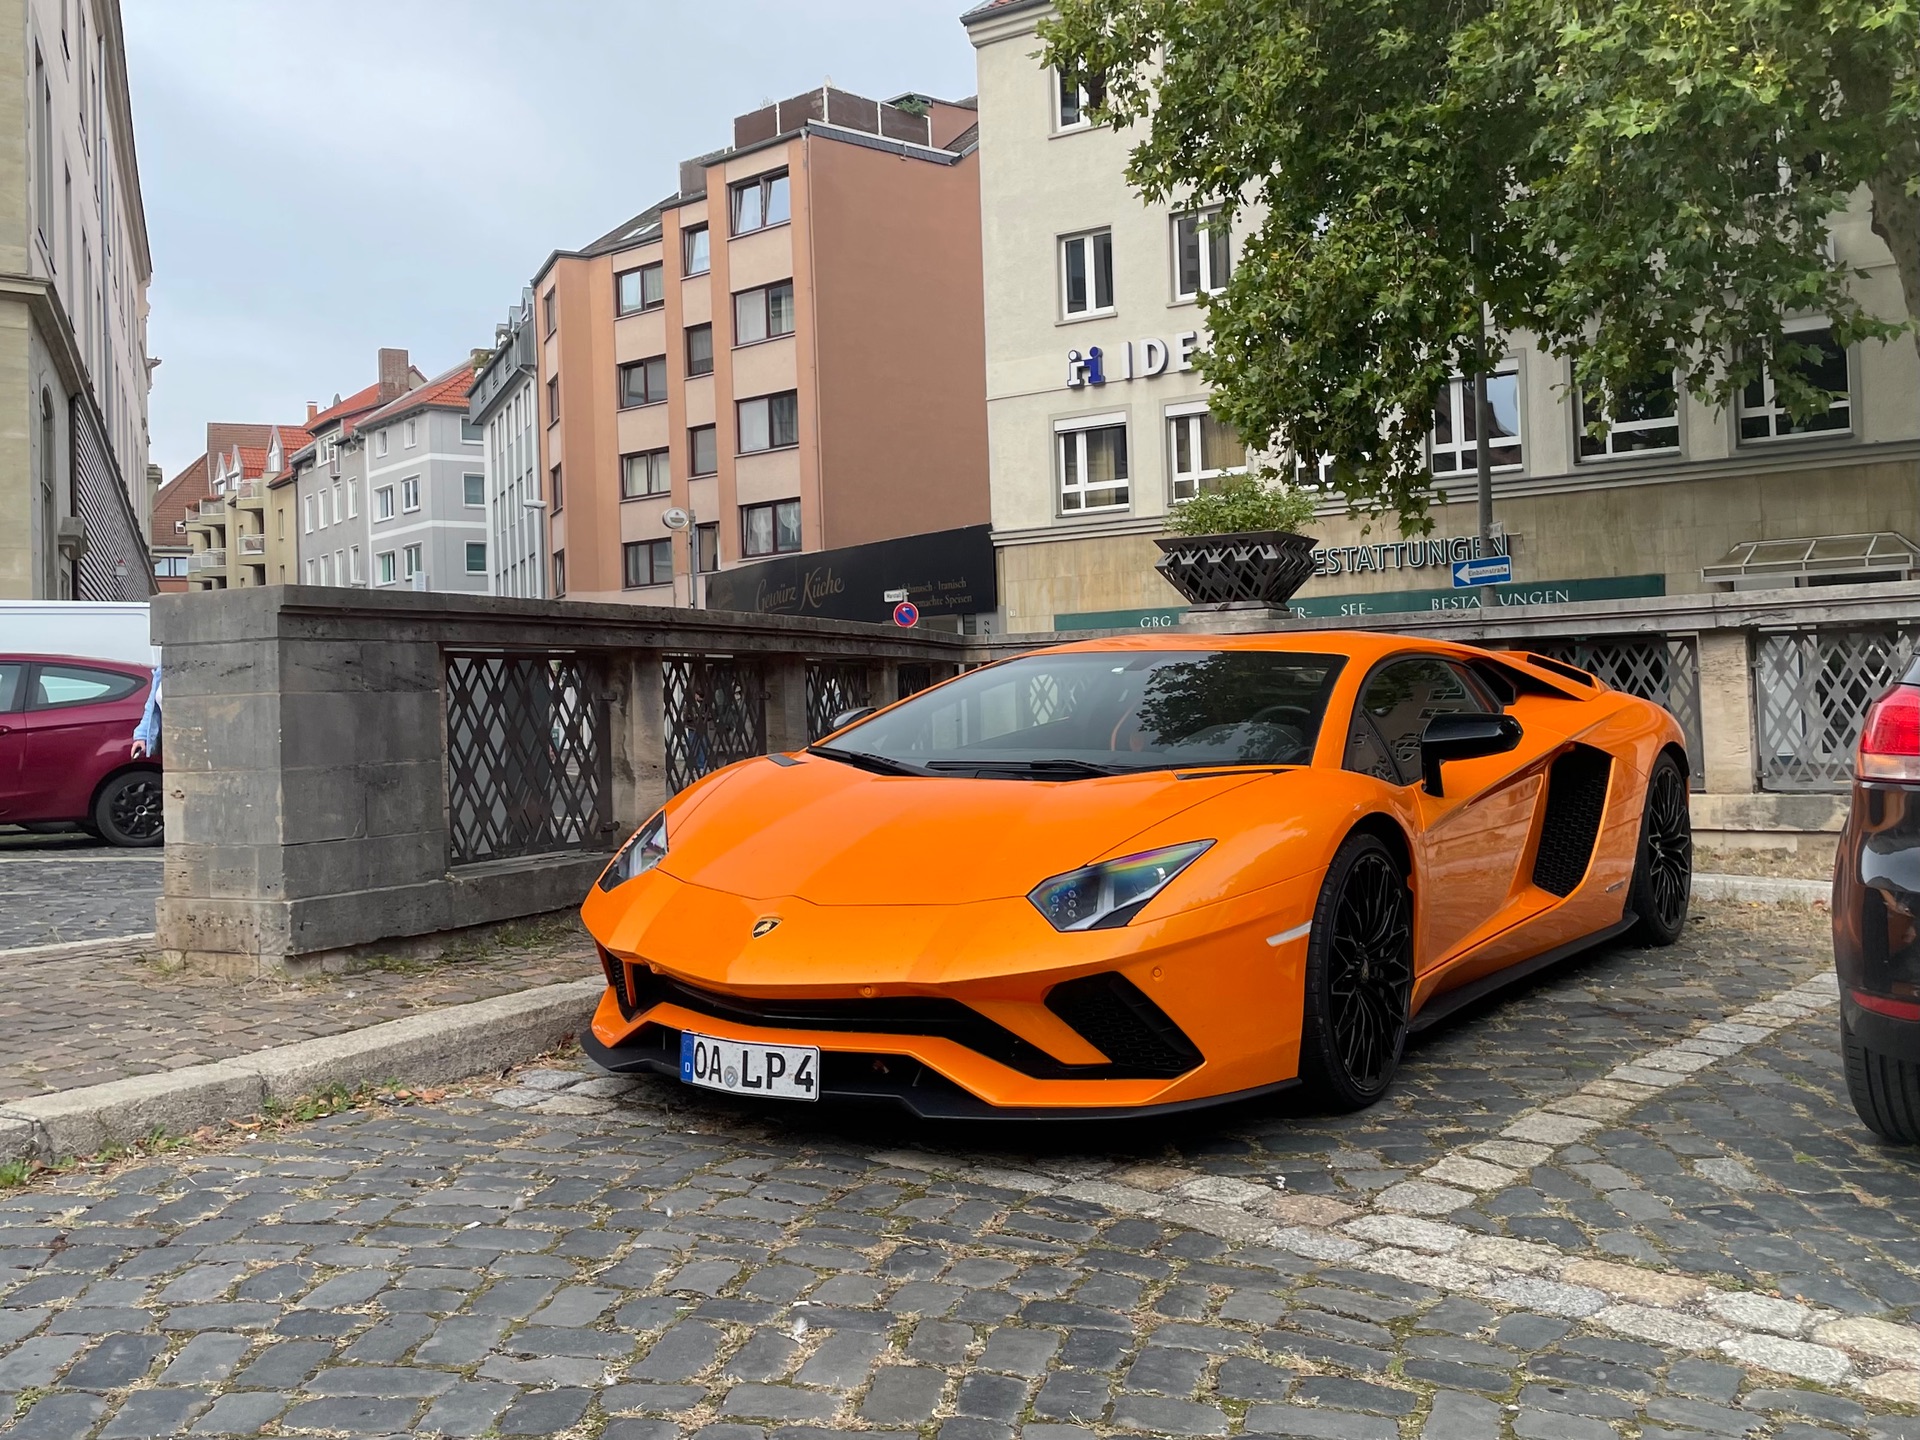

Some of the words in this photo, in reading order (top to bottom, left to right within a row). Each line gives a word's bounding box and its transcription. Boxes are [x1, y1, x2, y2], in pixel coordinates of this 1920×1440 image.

[1309, 533, 1509, 575] ESTATTUNGEN
[1468, 565, 1508, 577] Einbahnstraße
[756, 578, 797, 613] Gewürz
[799, 566, 845, 611] Küche
[938, 576, 967, 590] Iranisch
[944, 593, 972, 608] Speisen
[1431, 589, 1569, 611] BESTAUNGEN
[684, 1061, 691, 1073] D
[694, 1041, 722, 1083] OA
[742, 1050, 786, 1090] LP
[794, 1054, 814, 1093] 4
